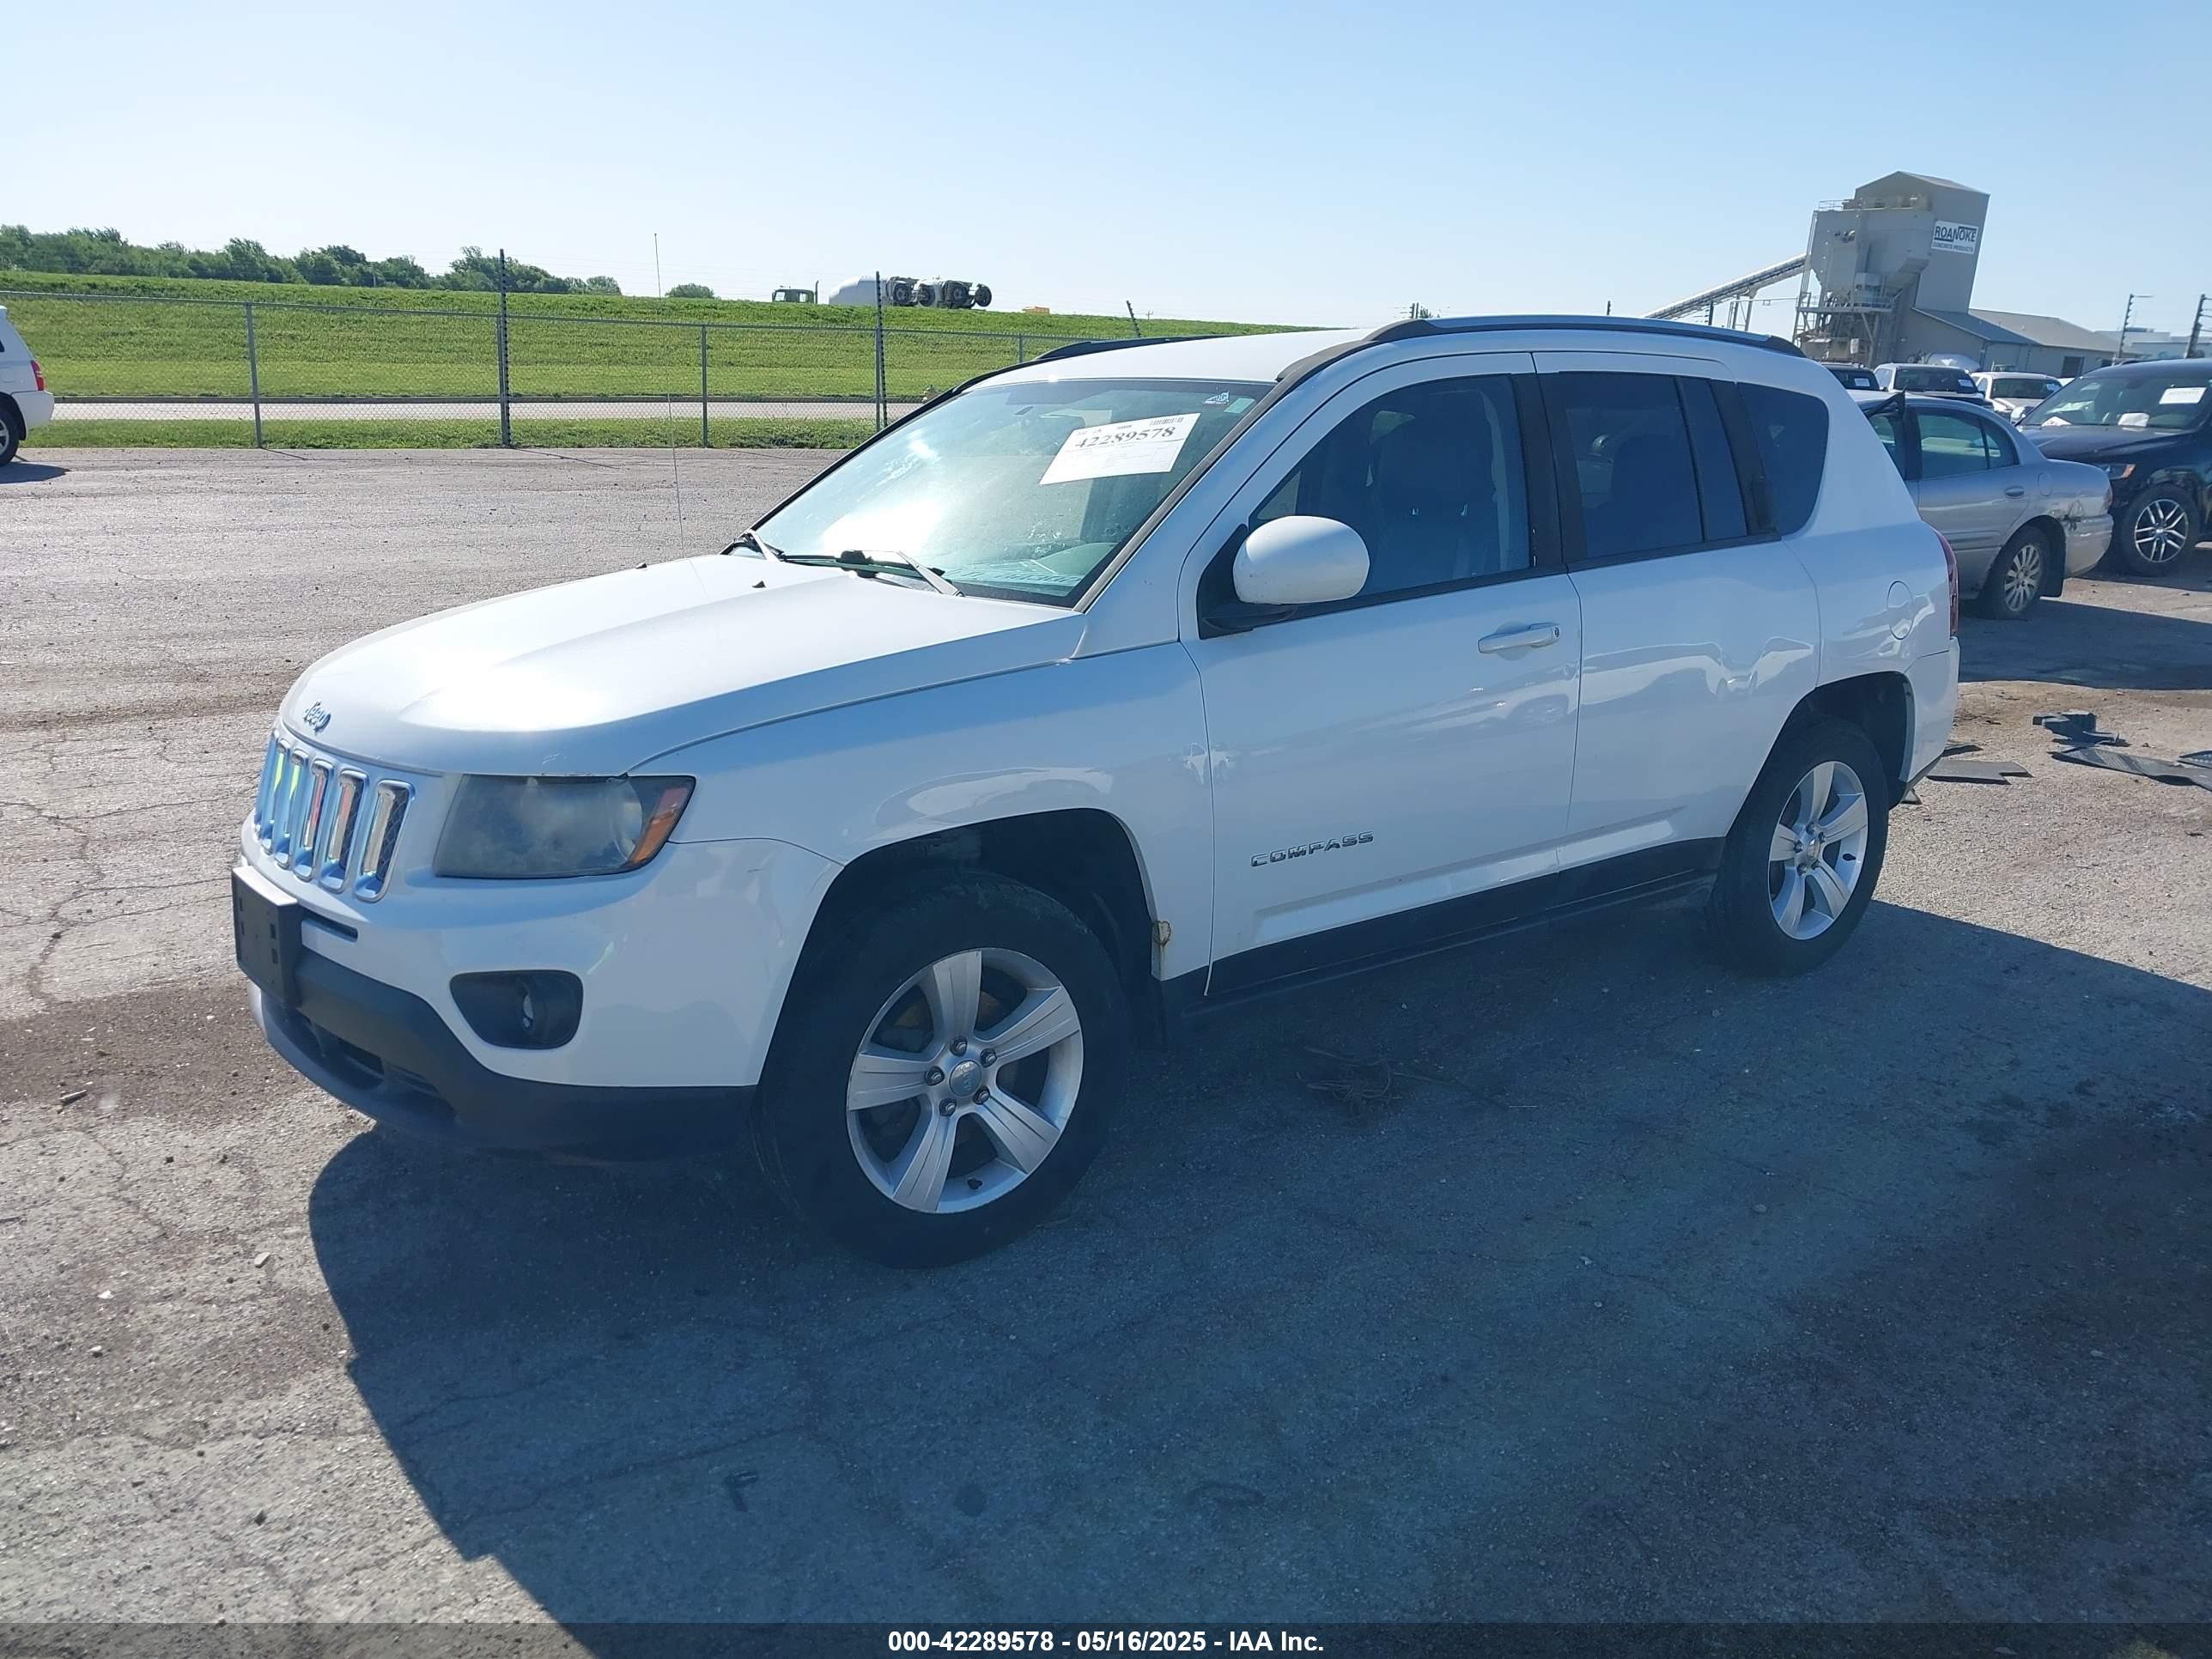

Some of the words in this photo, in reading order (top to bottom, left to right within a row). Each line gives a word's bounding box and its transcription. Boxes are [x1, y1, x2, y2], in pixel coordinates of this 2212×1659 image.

[1935, 226, 1977, 242] ROANOKE
[1075, 427, 1176, 447] 42289578
[304, 701, 331, 736] Jeep
[1250, 831, 1374, 867] COMPASS
